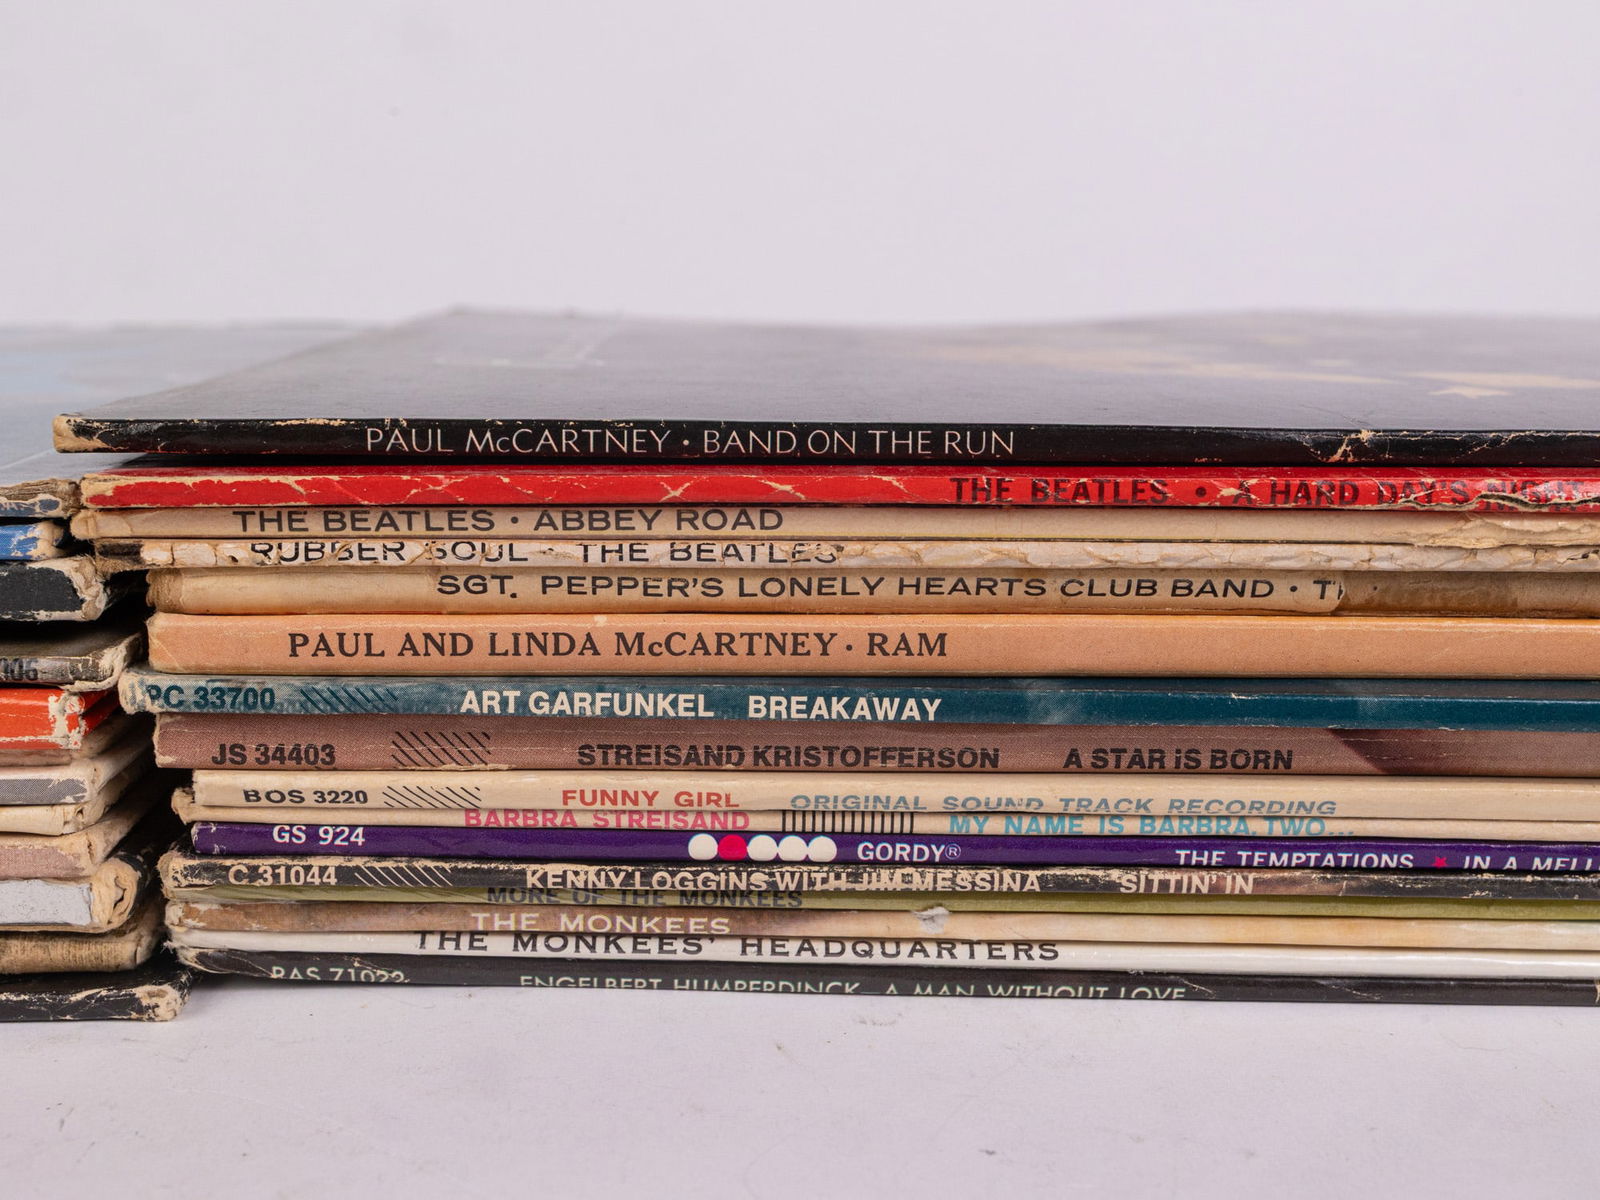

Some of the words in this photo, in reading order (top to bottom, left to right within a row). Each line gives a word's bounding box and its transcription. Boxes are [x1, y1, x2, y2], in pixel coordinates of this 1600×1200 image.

[366, 428, 453, 453] PAUL
[465, 428, 671, 454] McCARTNEY
[704, 429, 797, 454] BAND
[807, 430, 856, 455] ON
[868, 430, 932, 455] THE
[944, 431, 1014, 455] RUN
[949, 478, 1014, 503] THE
[1031, 478, 1168, 504] BEATLES
[1270, 479, 1360, 506] HARD
[1377, 480, 1470, 506] DAY'S
[232, 510, 309, 532] THE
[323, 510, 495, 532] BEATLES
[533, 509, 662, 531] ABBEY
[676, 508, 784, 531] ROAD
[250, 541, 406, 563] RUBBER
[424, 541, 528, 562] SOUL
[579, 541, 650, 563] THE
[669, 541, 837, 564] BEATLES
[437, 574, 518, 599] SGT.
[541, 575, 723, 598] PEPPER'S
[738, 576, 885, 597] LONELY
[898, 577, 1047, 597] HEARTS
[1060, 578, 1157, 597] CLUB
[1171, 579, 1274, 599] BAND
[288, 632, 385, 658] PAUL
[397, 632, 474, 657] AND
[488, 631, 600, 657] LINDA
[615, 631, 838, 657] McCARTNEY
[866, 632, 948, 657] RAM
[145, 684, 184, 709] PC
[193, 685, 276, 711] 33700
[460, 690, 521, 715] ART
[528, 691, 714, 718] GARFUNKEL
[748, 695, 942, 721] BREAKAWAY
[211, 743, 247, 766] JS
[255, 743, 336, 766] 34403
[577, 744, 745, 768] STREISAND
[753, 745, 1000, 769] KRISTOFFERSON
[1062, 748, 1083, 769] A
[1090, 748, 1166, 770] STAR
[1210, 749, 1293, 771] BORN
[243, 788, 305, 804] BOS
[313, 789, 368, 805] 3220
[562, 789, 660, 806] FUNNY
[674, 791, 740, 808] GIRL
[790, 795, 928, 811] ORIGINAL
[942, 796, 1044, 812] SOUND
[1059, 797, 1154, 814] TRACK
[1168, 798, 1337, 815] RECORDING
[464, 809, 578, 828] BARBRA
[592, 810, 750, 830] STREISAND
[949, 815, 989, 834] MY
[1004, 816, 1085, 835] NAME
[1100, 816, 1125, 835] IS
[272, 825, 306, 844] GS
[319, 826, 365, 847] 924
[1175, 849, 1225, 867] THE
[1237, 851, 1414, 869] TEMPTATIONS
[1463, 855, 1491, 870] IN
[1503, 856, 1518, 870] A
[228, 865, 249, 885] C
[261, 866, 338, 886] 31044
[526, 870, 627, 889] KENNY
[634, 871, 770, 891] LOGGINS
[775, 871, 847, 891] WITH
[911, 872, 1042, 892] MESSINA
[1119, 873, 1217, 894] SITTIN'
[1225, 873, 1254, 894] IN
[486, 888, 561, 905] MORE
[572, 888, 605, 905] OF
[616, 889, 667, 906] THE
[678, 890, 804, 908] MONKEES
[471, 912, 541, 931] THE
[559, 913, 731, 935] MONKEES
[413, 931, 489, 951] THE
[740, 936, 1060, 961] HEADQUARTERS
